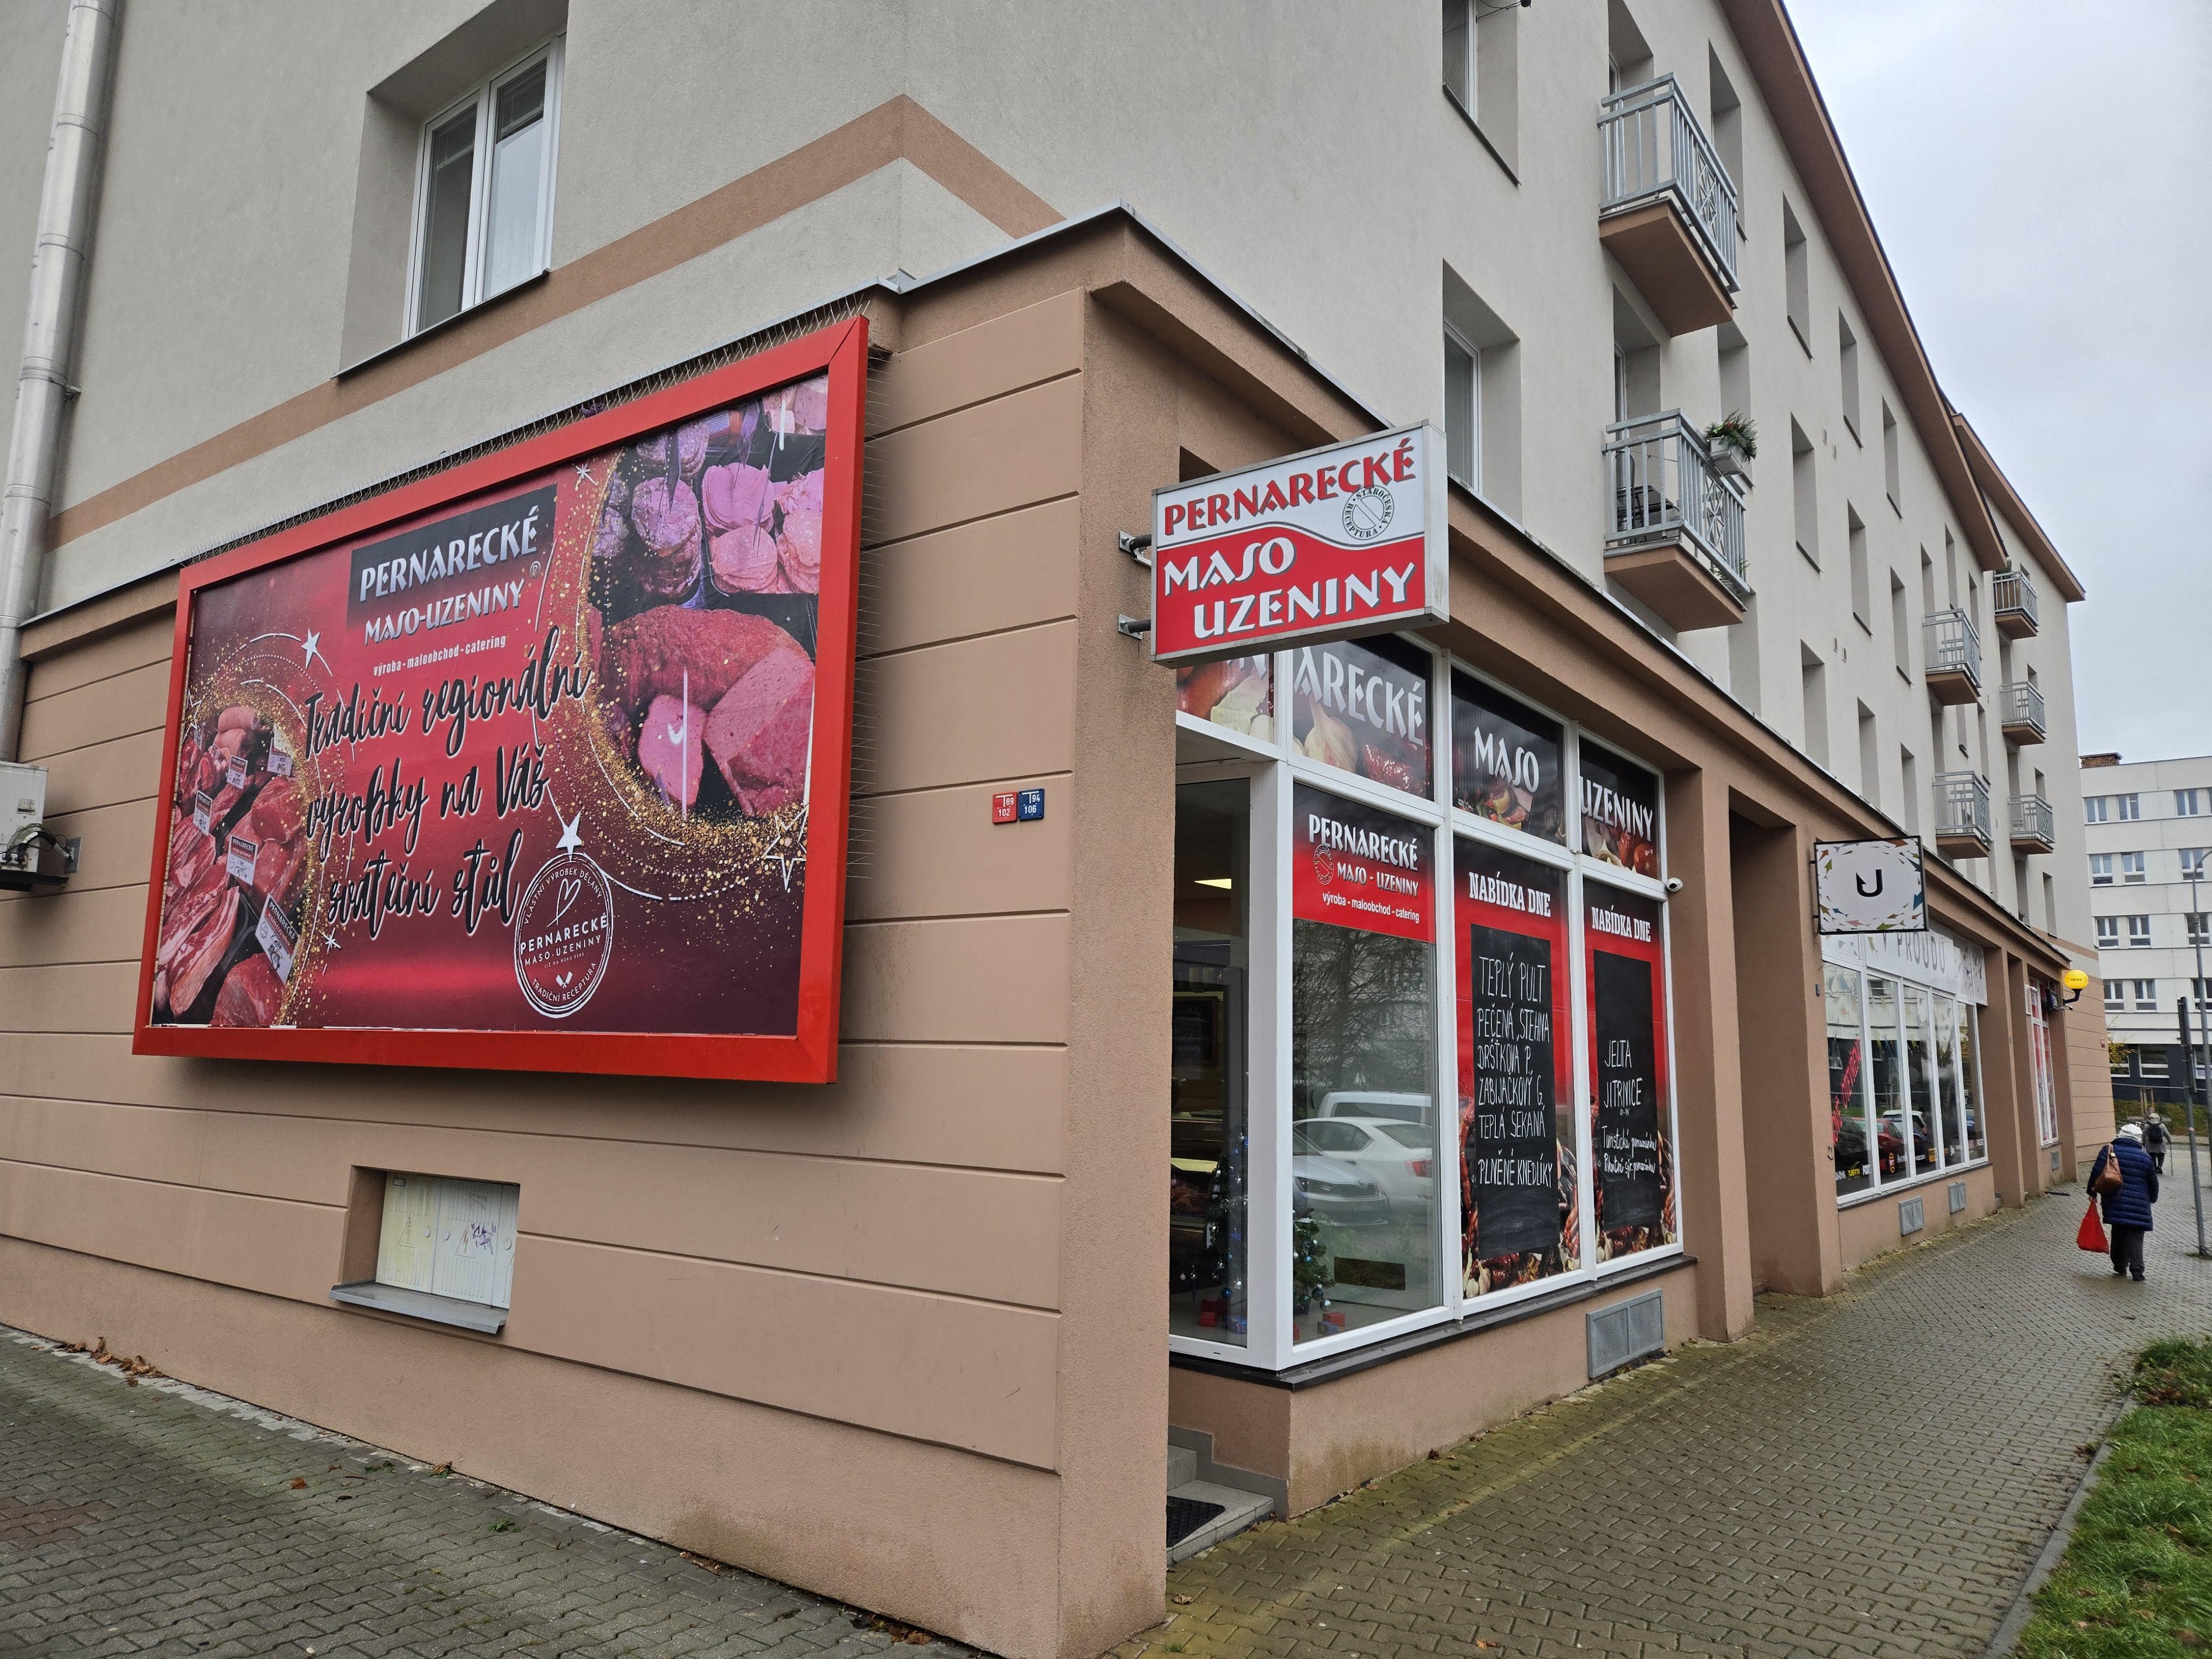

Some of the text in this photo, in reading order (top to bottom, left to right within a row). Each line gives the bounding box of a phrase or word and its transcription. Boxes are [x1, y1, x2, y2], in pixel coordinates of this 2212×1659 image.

[1164, 437, 1416, 536] PERNARECKÉ
[1356, 488, 1392, 524] STAROČESKÁ
[1345, 503, 1378, 538] RECEPTURA
[359, 505, 539, 602] PERNARECKÉ
[1164, 537, 1296, 596] MASO
[365, 578, 524, 646] MASO-UZENINY
[1194, 562, 1416, 639] UZENINY
[305, 625, 594, 759] Tradiční regionální
[1474, 726, 1539, 794] MASO
[306, 742, 550, 863] výrobky na Váš
[1024, 805, 1036, 814] 106
[1579, 775, 1653, 843] UZENINY
[1309, 814, 1418, 872] PERNARECKÉ
[327, 828, 524, 940] sváteční stůl
[524, 884, 545, 925] VLASTNÍ
[546, 867, 578, 885] VÝROBEK
[1337, 861, 1367, 885] MASO
[1376, 872, 1418, 898] UZENINY
[1469, 871, 1552, 917] NABÍDKA DNE
[269, 901, 295, 940] PERNARECKÉ
[1323, 891, 1346, 906] výroba
[1352, 899, 1390, 915] maloobchod
[1396, 909, 1419, 924] catering
[1592, 905, 1651, 943] NABÍDKA DNE
[520, 912, 608, 955] PERNARECKÉ
[1897, 932, 1945, 973] PROUDU
[532, 962, 597, 1002] TRADIČNÍ RECEPTURA
[1479, 952, 1546, 1003] TEPLÝ PULT
[1477, 1002, 1550, 1043] PEČENÁ STEHNA
[1479, 1070, 1533, 1106] ZABIJAČKOVÝ
[1604, 1077, 1643, 1108] JITRNICE
[1478, 1105, 1546, 1139] TEPLÁ SEKANÁ
[1602, 1125, 1630, 1150] Turistická
[1478, 1148, 1553, 1188] PLNĚNÉ KNEDLÍKY
